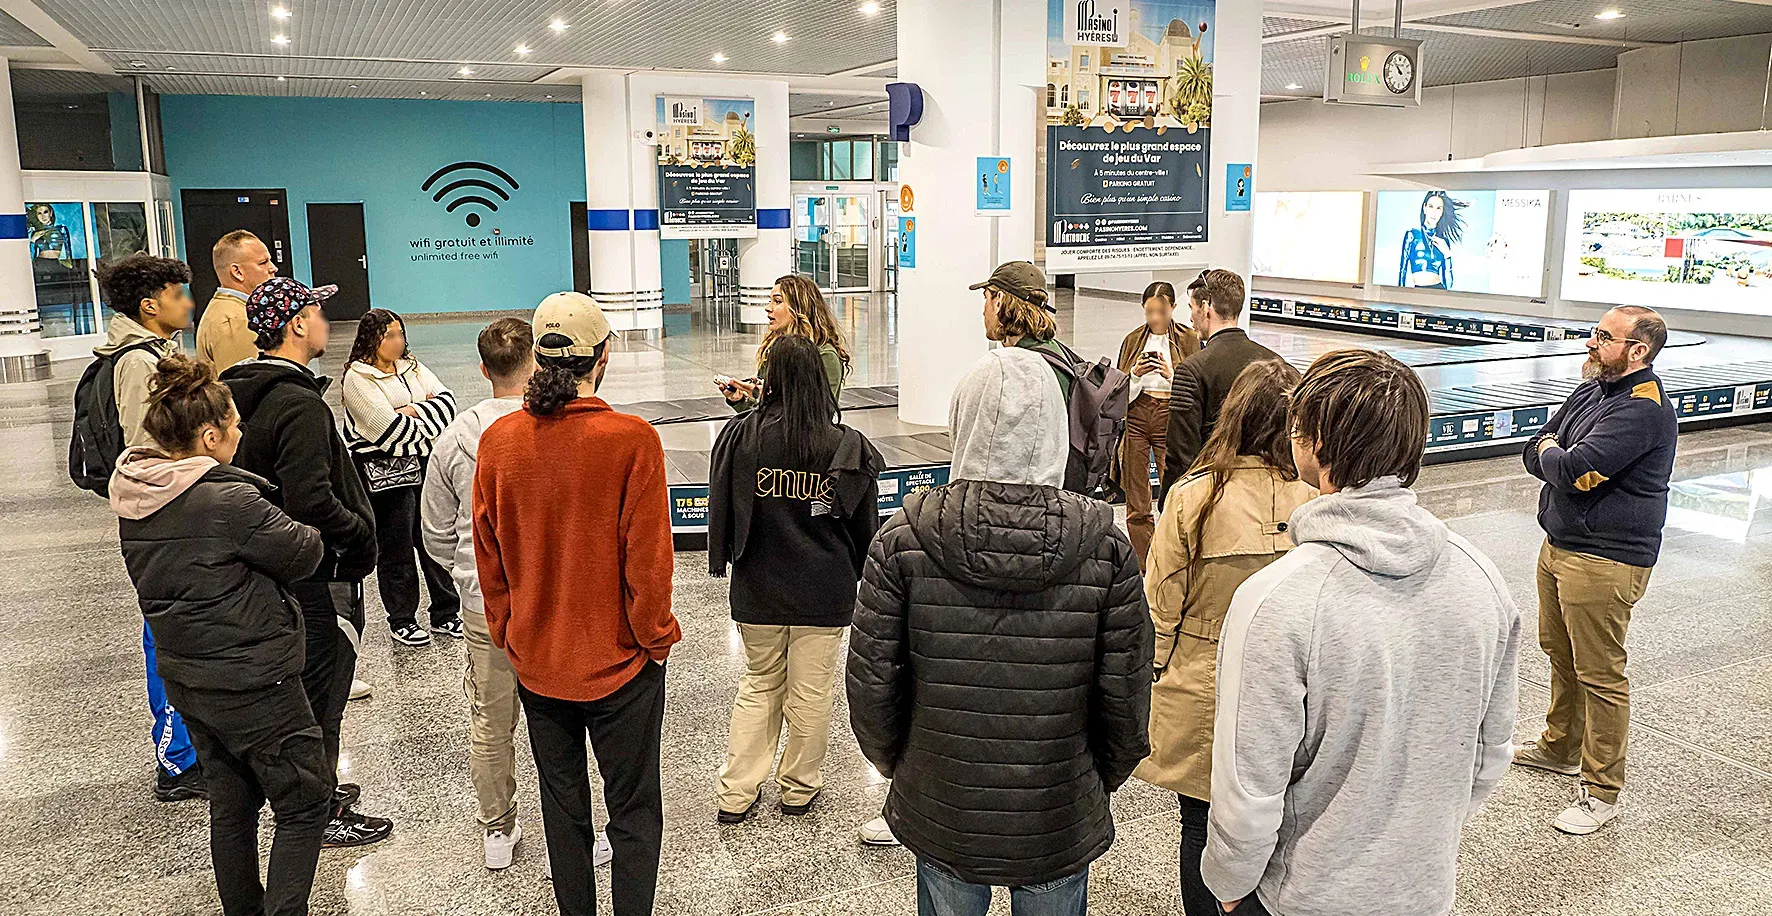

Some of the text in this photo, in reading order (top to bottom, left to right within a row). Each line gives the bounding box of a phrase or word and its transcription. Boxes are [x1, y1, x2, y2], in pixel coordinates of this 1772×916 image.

[1347, 72, 1380, 84] ROLEX
[1060, 140, 1201, 154] Découvrez le plus grand espace
[1103, 153, 1161, 165] de jeu du Var
[1080, 192, 1101, 204] Bien
[1100, 194, 1117, 205] plus
[1136, 193, 1159, 205] simple
[1160, 193, 1182, 202] casino
[1501, 198, 1541, 207] MESSIKA
[409, 235, 534, 250] wifi gratuit et illimité
[411, 250, 498, 261] unlimited free wifi
